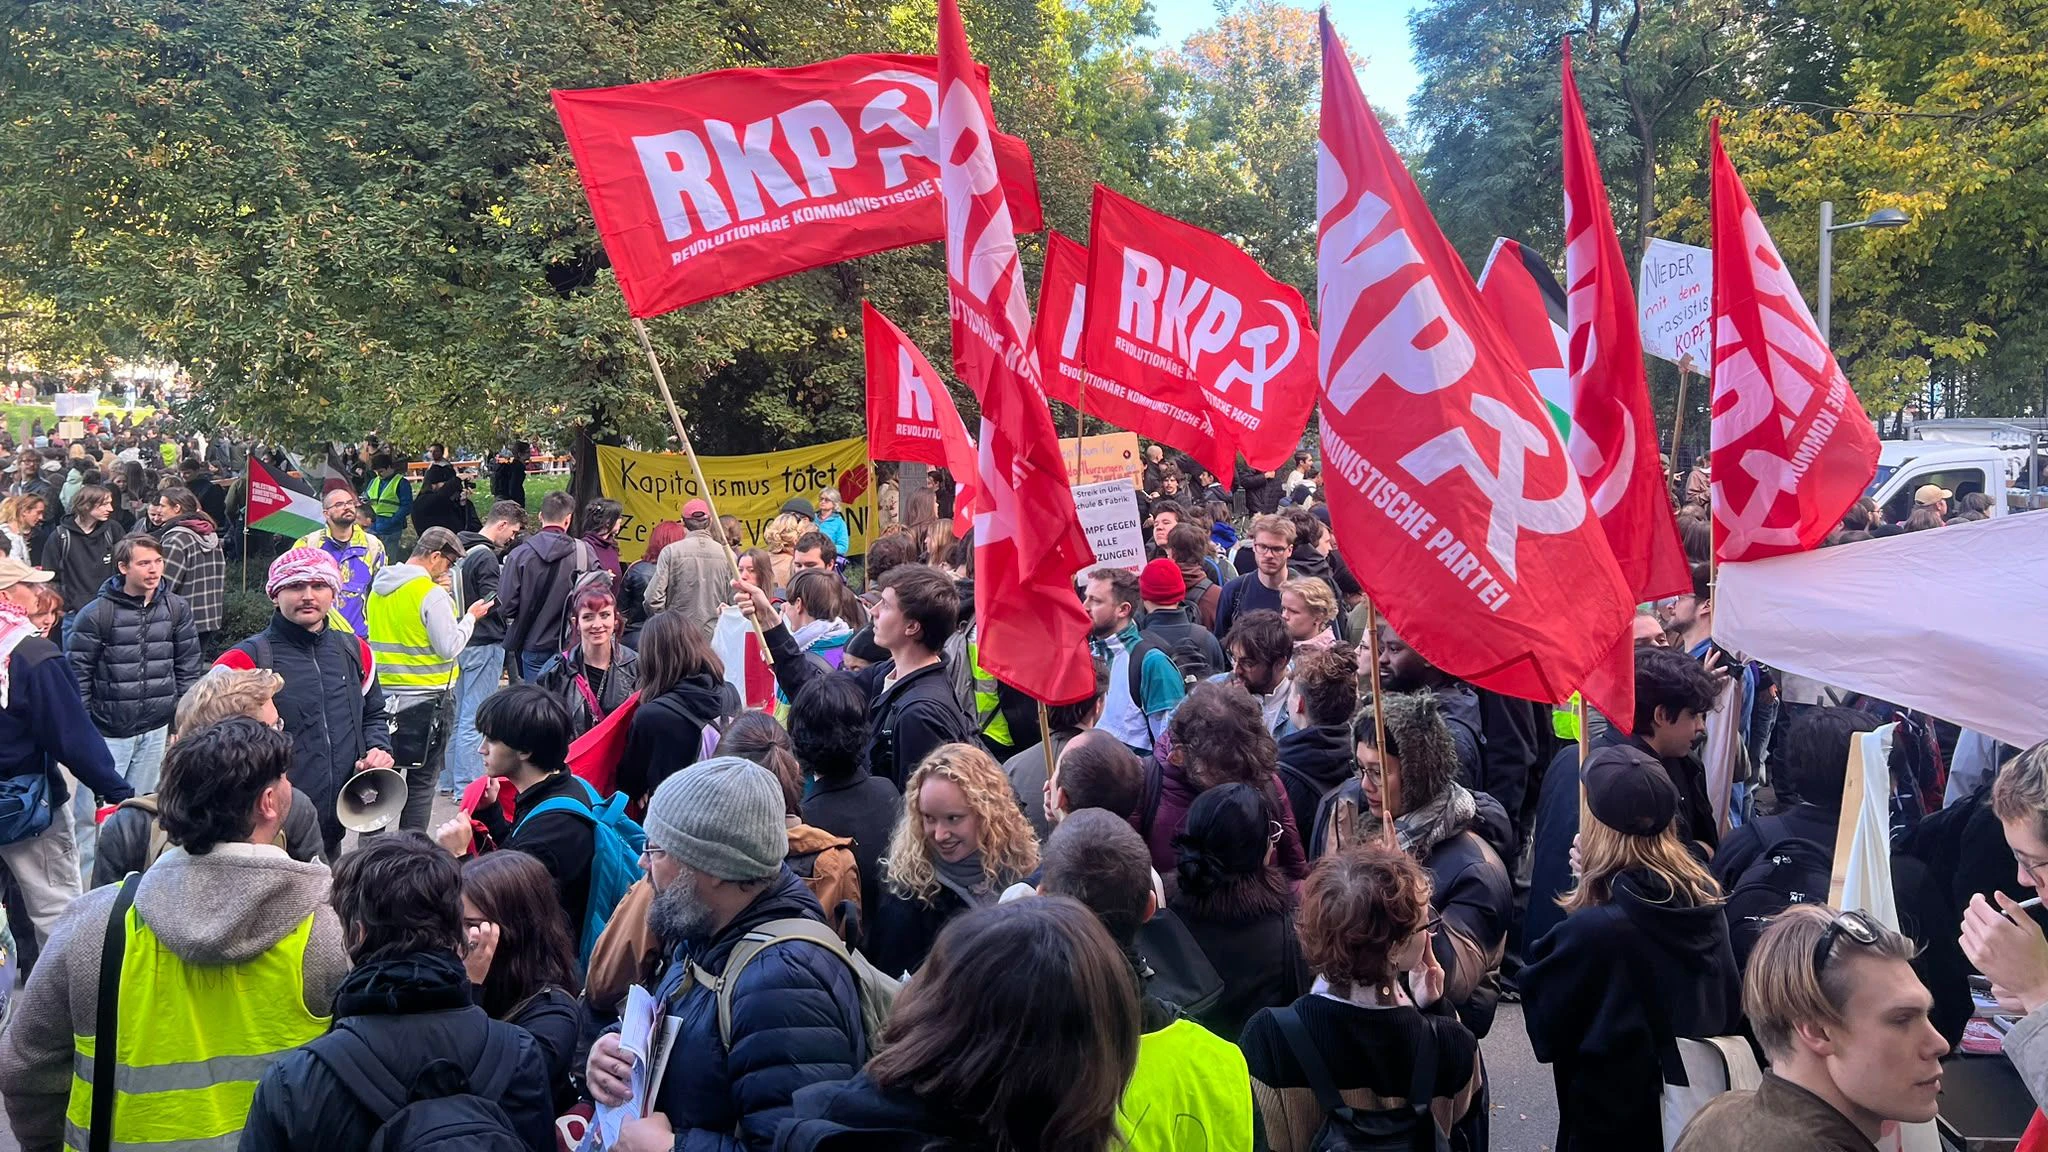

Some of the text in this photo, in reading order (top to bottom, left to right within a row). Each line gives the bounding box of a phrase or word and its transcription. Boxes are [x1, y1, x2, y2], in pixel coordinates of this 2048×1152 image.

[631, 99, 857, 243] RKP
[671, 178, 934, 266] REVOLUTIONÄRE KOMMUNISTISCHE
[1646, 253, 1694, 296] NIEDER
[1118, 246, 1242, 373] RKP
[1644, 282, 1701, 320] mit dem
[1059, 362, 1126, 398] REVOLUTIONÄRE
[1127, 389, 1201, 427] KOMMUNISTISCHE
[1115, 336, 1184, 377] REVOLUTIONÄRE
[1230, 407, 1261, 432] PARTEI
[895, 423, 942, 440] REVOLUTIO
[620, 458, 837, 503] Kapitaismus tötet
[1076, 489, 1098, 498] Streik
[1108, 485, 1122, 493] Uni,
[1105, 496, 1130, 505] Fabrik:
[1085, 520, 1137, 535] MPF GEGEN
[1096, 537, 1118, 548] ALLE
[1425, 516, 1511, 613] PARTEI
